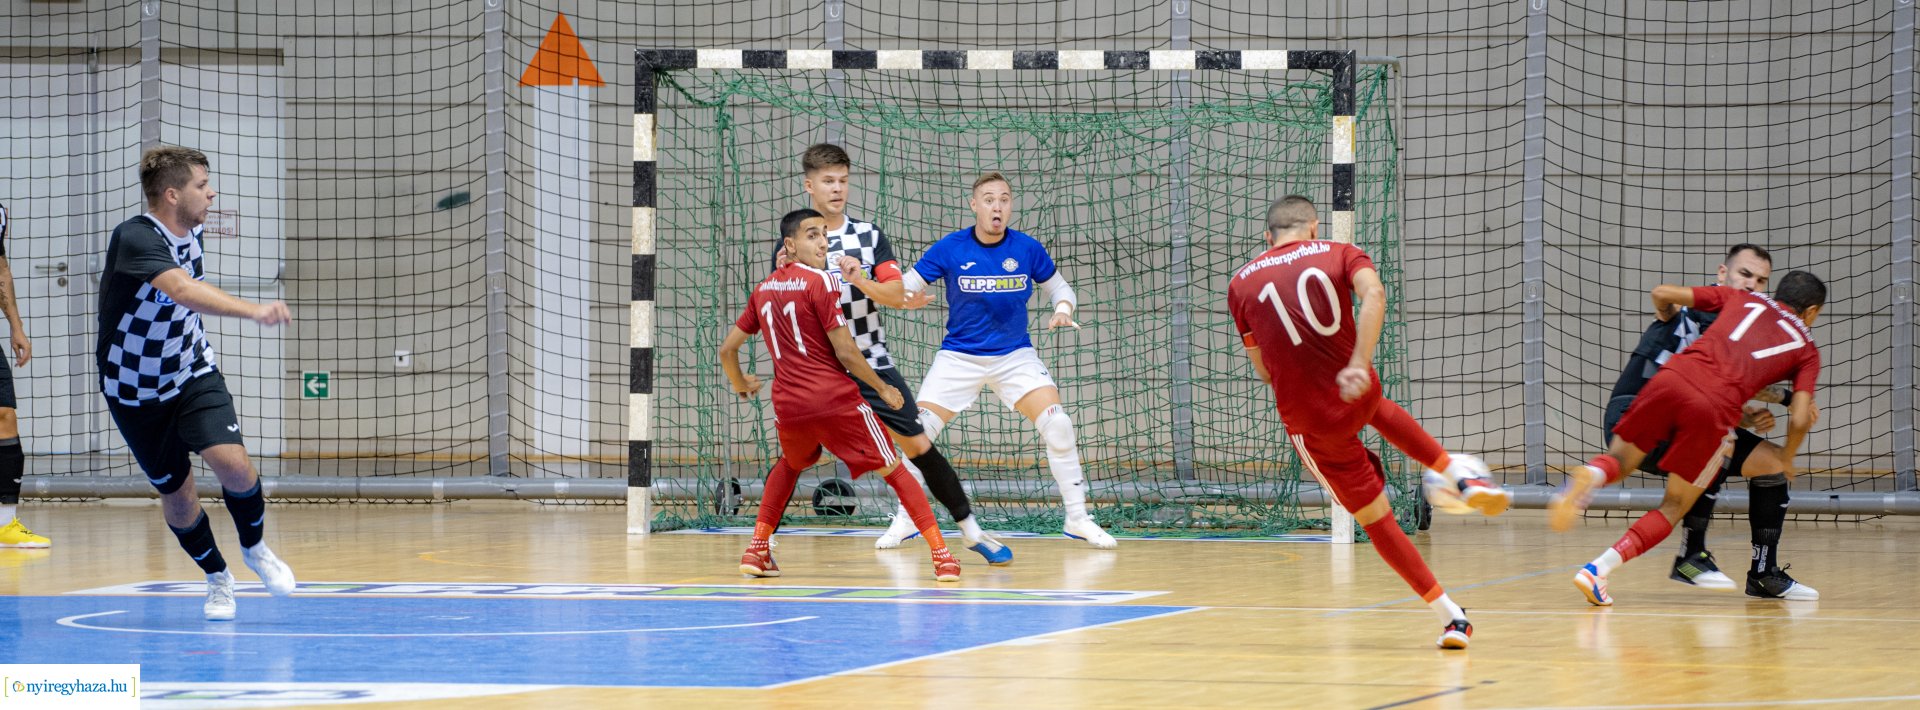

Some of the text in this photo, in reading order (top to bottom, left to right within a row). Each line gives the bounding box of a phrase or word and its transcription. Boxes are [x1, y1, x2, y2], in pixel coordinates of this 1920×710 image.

[1239, 242, 1331, 280] www.raktarsportbolt.hu
[761, 301, 808, 360] 11
[1258, 267, 1341, 346] 10
[1729, 302, 1806, 360] 17
